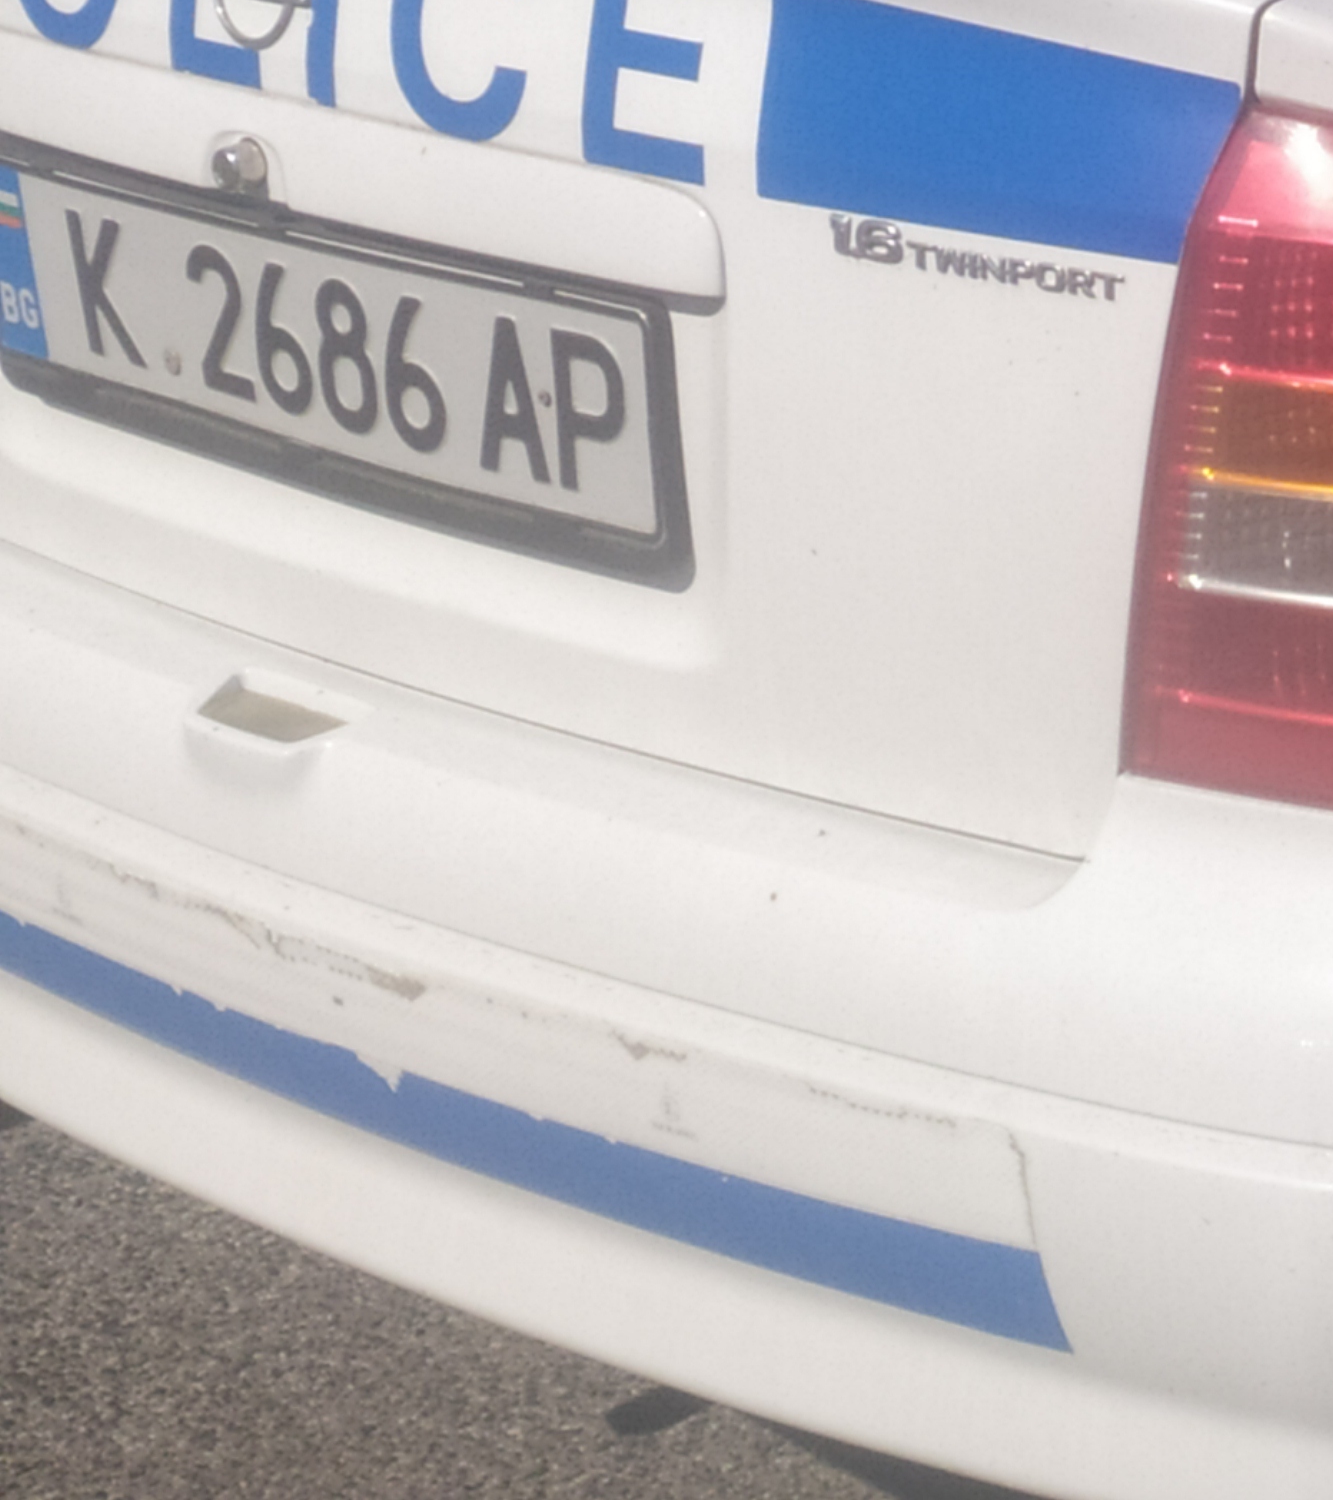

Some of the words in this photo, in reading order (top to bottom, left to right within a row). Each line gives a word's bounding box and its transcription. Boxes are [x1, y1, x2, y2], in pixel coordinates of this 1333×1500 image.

[905, 240, 1126, 301] TWINPORT
[0, 280, 39, 329] BG
[65, 208, 148, 369] K
[185, 243, 448, 454] 2686
[479, 315, 626, 492] AP
